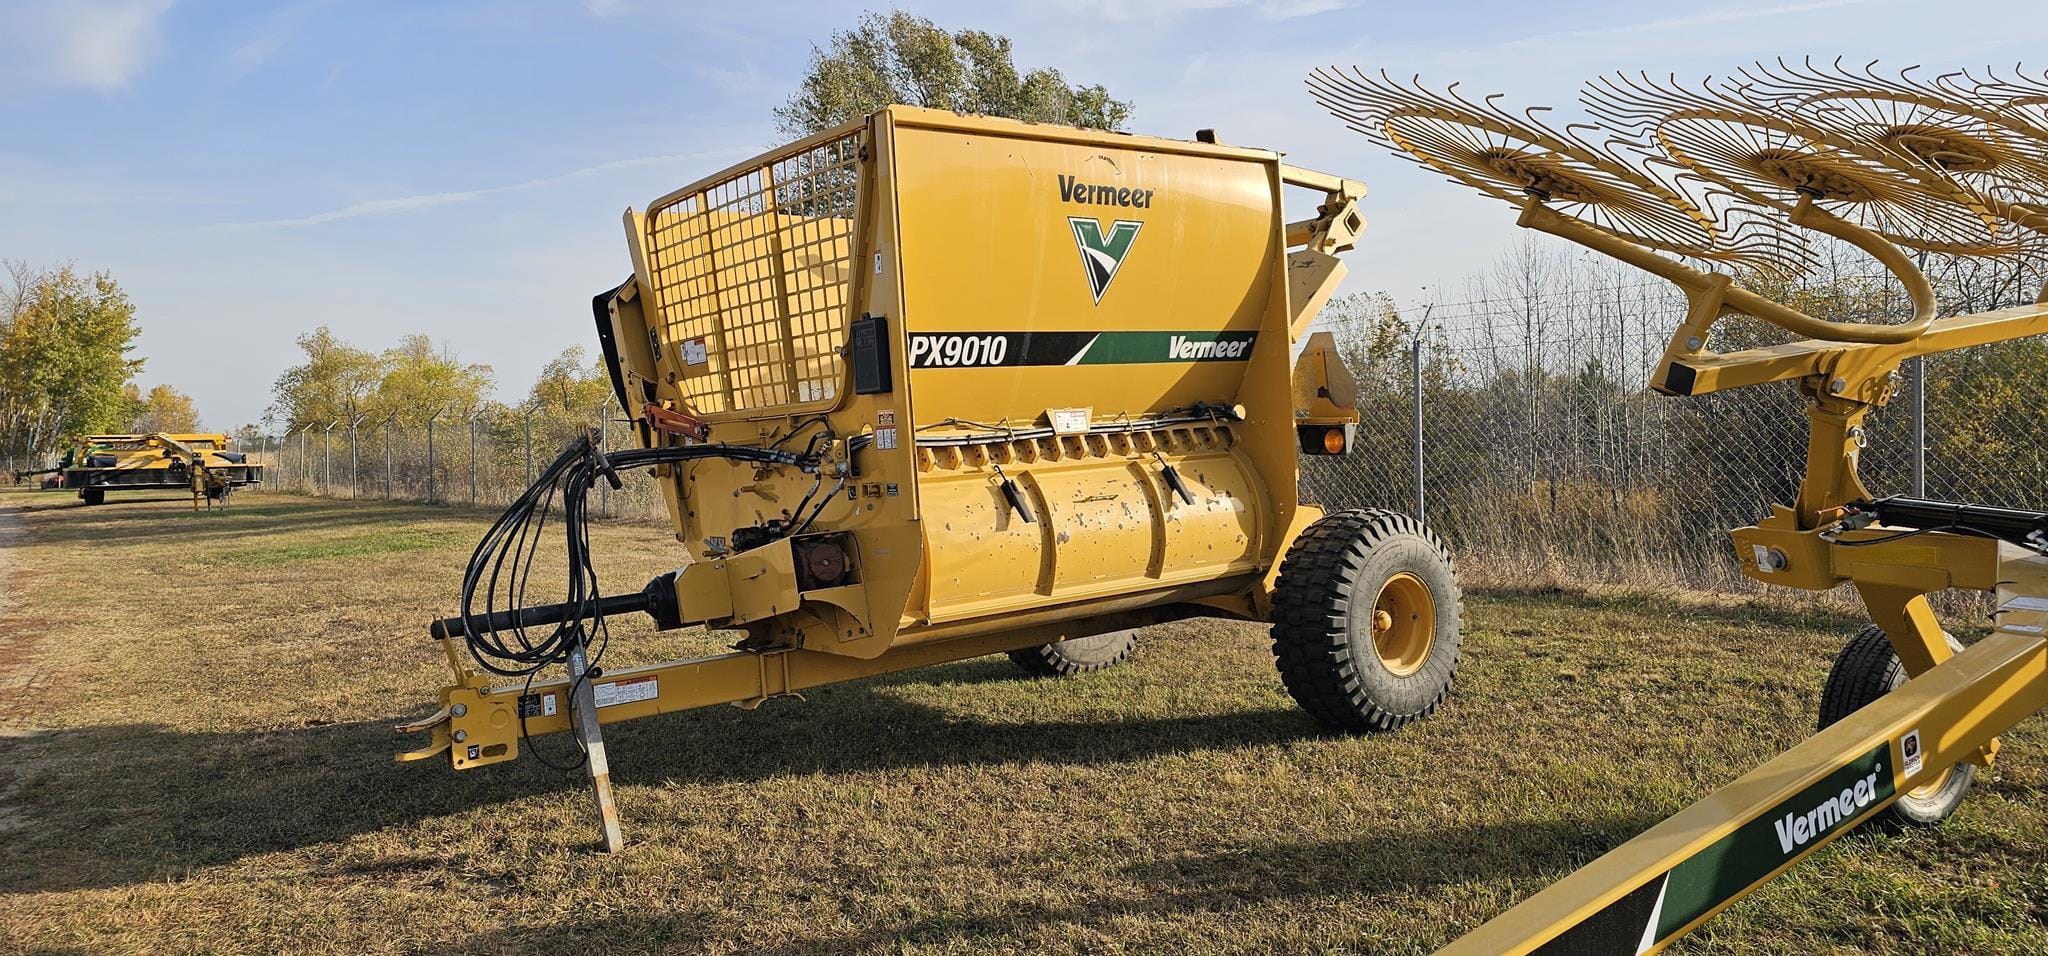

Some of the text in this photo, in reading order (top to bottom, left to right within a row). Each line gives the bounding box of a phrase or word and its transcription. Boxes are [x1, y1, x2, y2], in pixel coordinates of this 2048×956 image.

[1058, 174, 1153, 208] Vermeer
[908, 335, 1008, 367] PX9010
[1169, 335, 1248, 359] Vermeer
